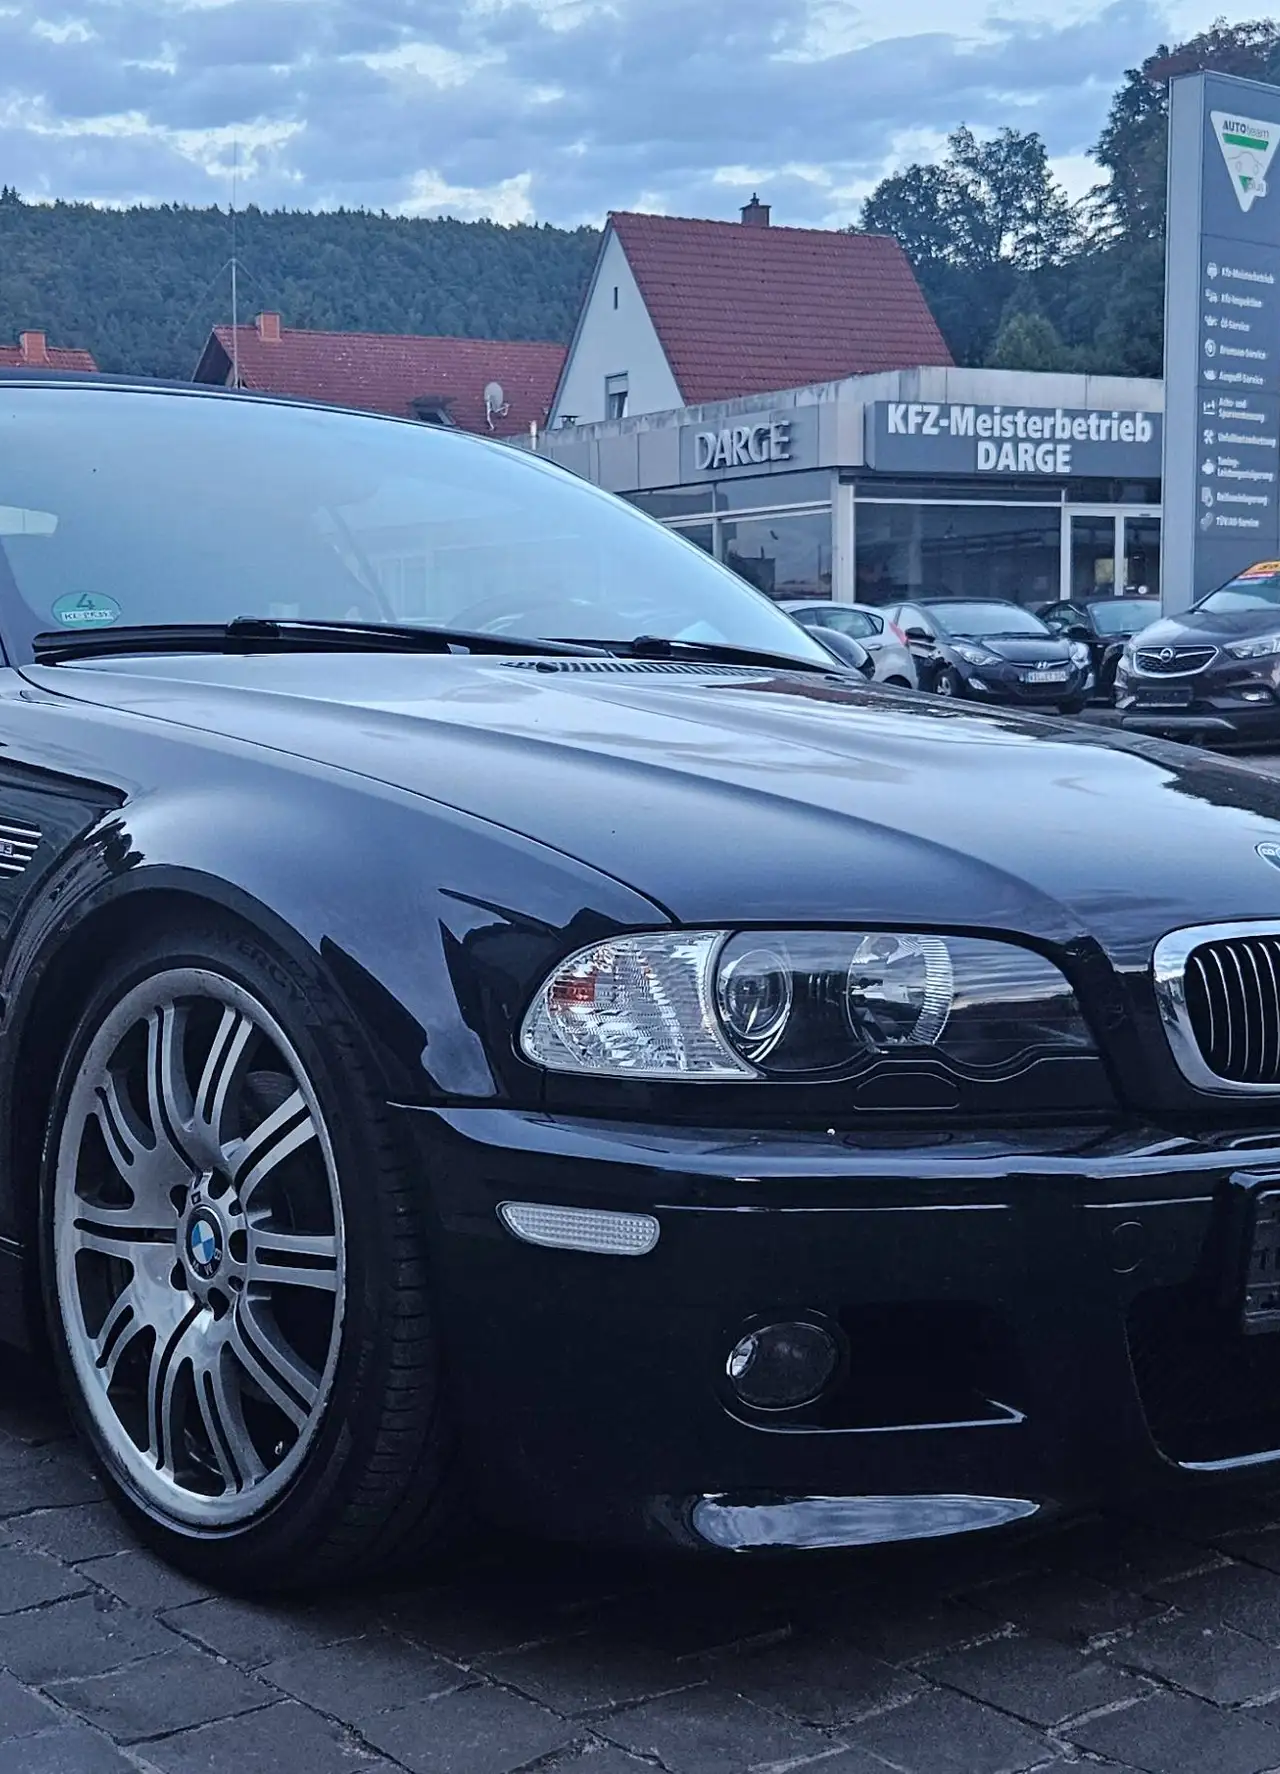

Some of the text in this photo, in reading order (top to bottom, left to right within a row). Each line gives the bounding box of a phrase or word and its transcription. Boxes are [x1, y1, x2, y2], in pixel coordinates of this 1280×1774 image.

[886, 402, 1152, 443] KFZ-Meisterbetrieb
[693, 419, 792, 471] DARGE
[976, 441, 1072, 474] DARGE
[76, 593, 96, 610] 4
